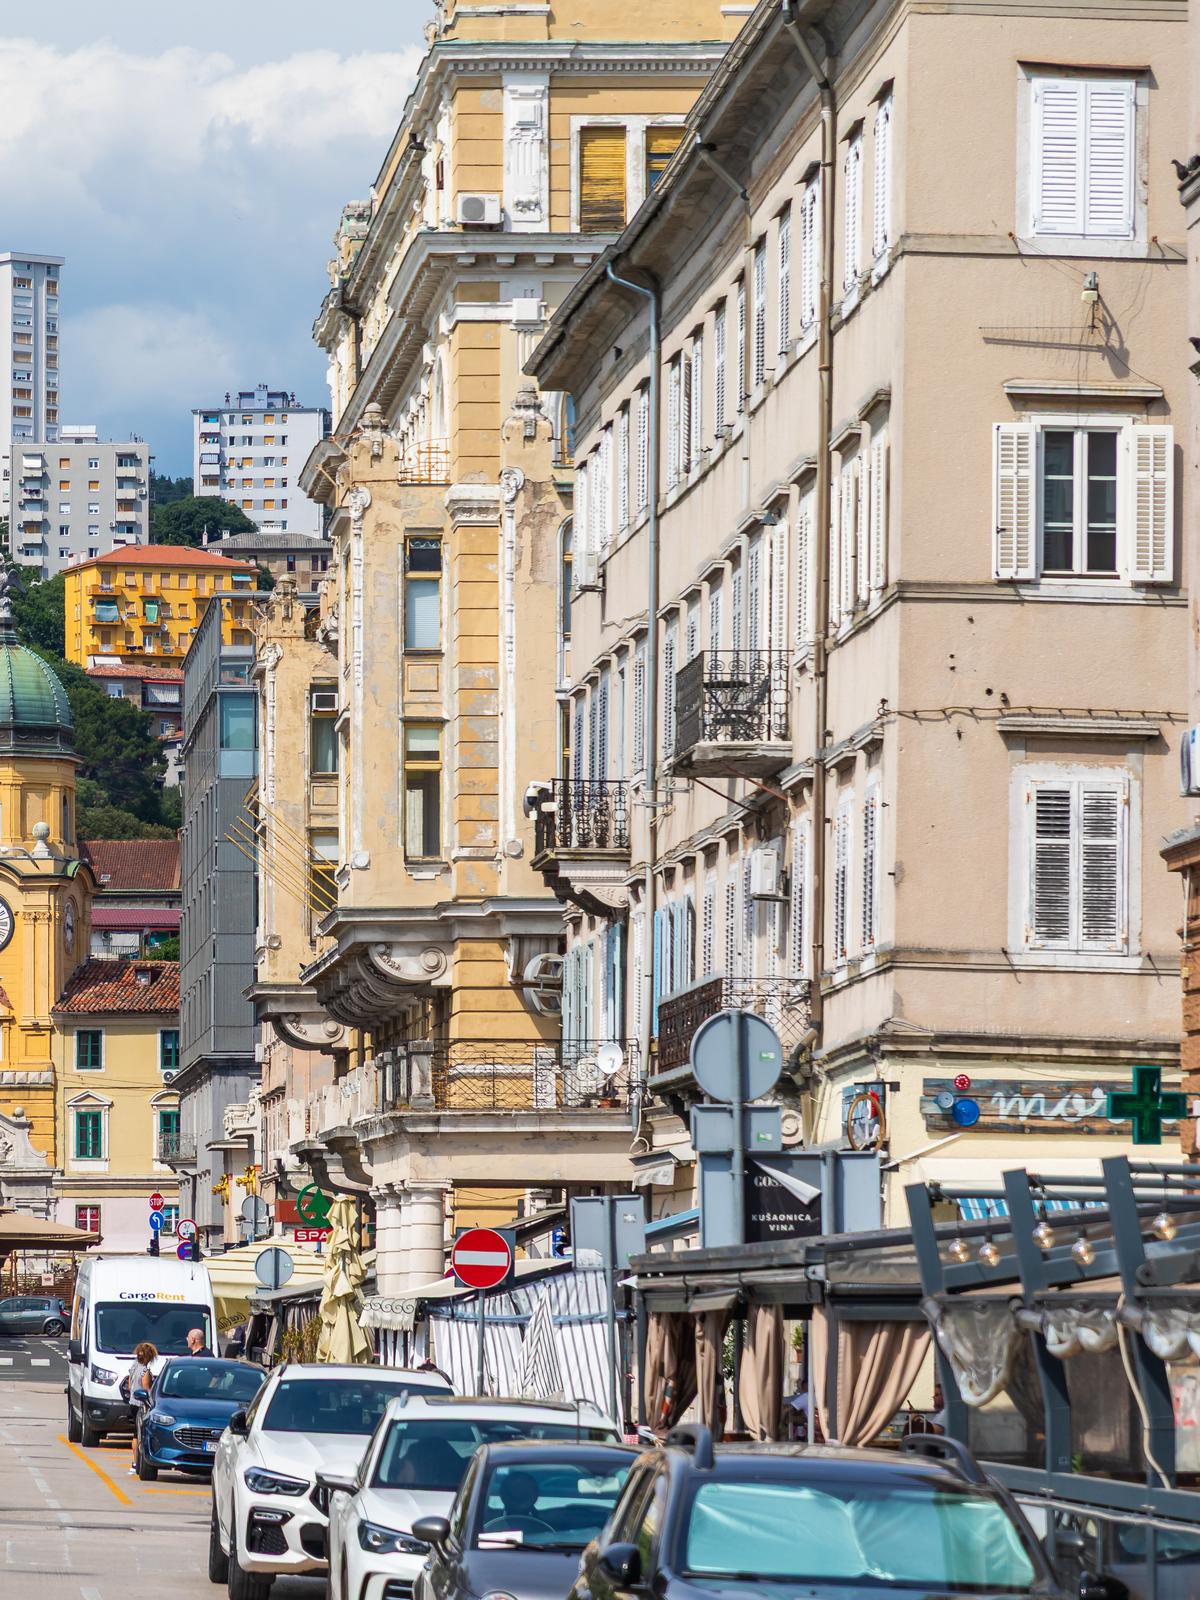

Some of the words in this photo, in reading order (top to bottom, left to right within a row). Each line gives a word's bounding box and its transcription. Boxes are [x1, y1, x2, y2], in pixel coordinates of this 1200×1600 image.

[150, 1198, 164, 1206] STOP
[769, 1224, 795, 1232] VINA
[297, 1231, 329, 1241] SPA
[119, 1291, 185, 1301] CargoRent
